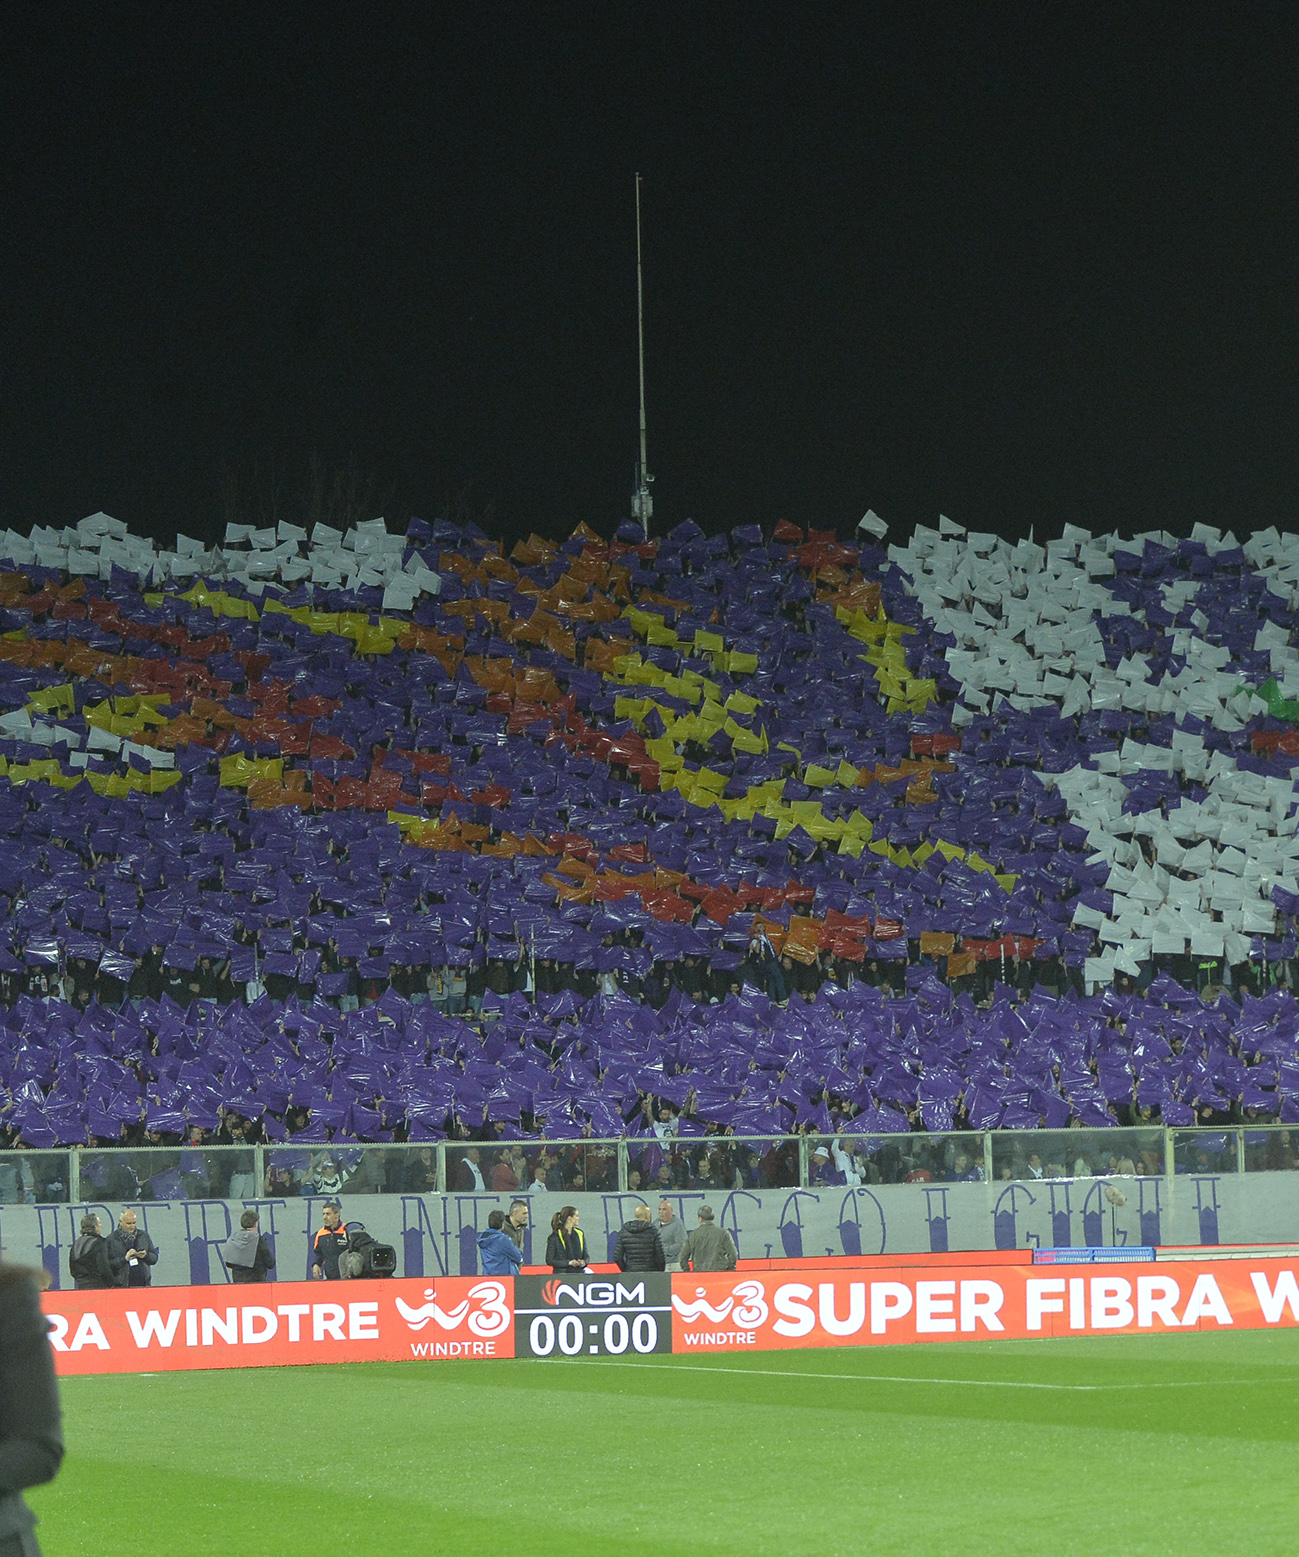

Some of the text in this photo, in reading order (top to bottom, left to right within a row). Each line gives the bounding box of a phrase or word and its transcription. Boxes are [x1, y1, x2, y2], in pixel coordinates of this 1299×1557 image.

[555, 1281, 645, 1306] NGM
[773, 1280, 1006, 1338] SUPER
[1026, 1273, 1233, 1331] FIBRA
[125, 1301, 380, 1349] WINDTRE
[529, 1313, 658, 1356] 00:00
[684, 1331, 756, 1346] WINDTRE
[410, 1341, 496, 1357] WINDTRE
